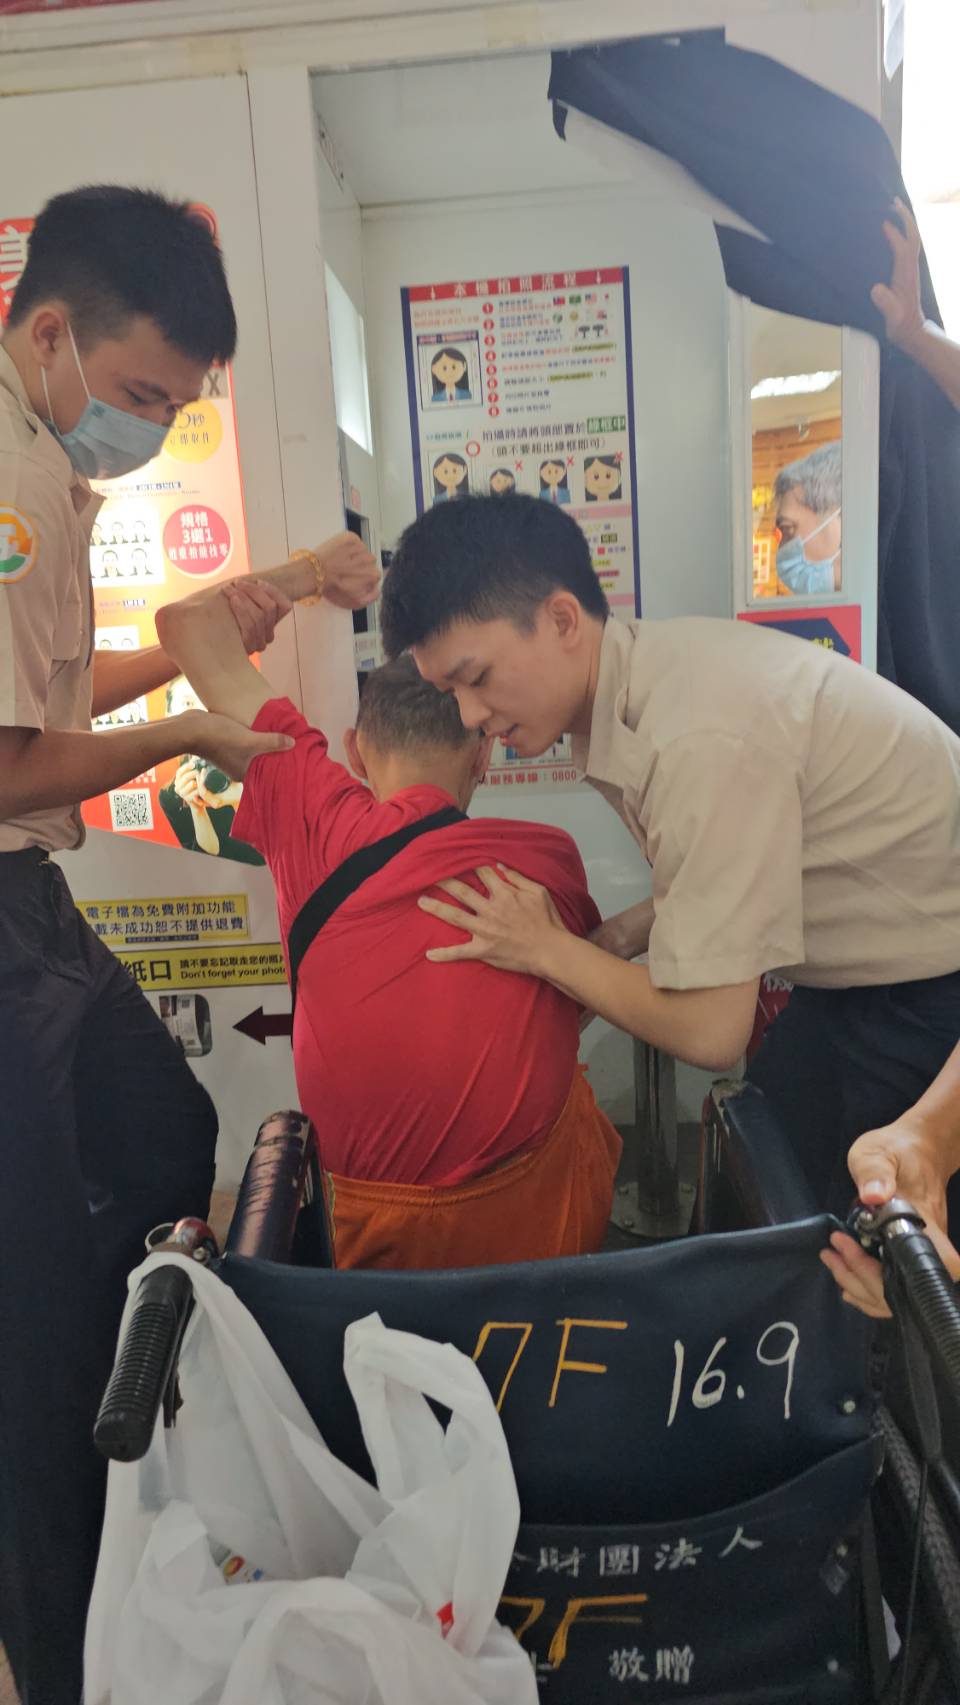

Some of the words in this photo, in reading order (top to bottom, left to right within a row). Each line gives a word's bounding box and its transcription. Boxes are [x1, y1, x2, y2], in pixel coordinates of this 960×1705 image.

[86, 900, 235, 919] 電子檔為免費附加功能
[181, 970, 206, 980] Don't
[208, 968, 236, 978] forget
[239, 967, 258, 978] your
[667, 1321, 799, 1428] 16.9
